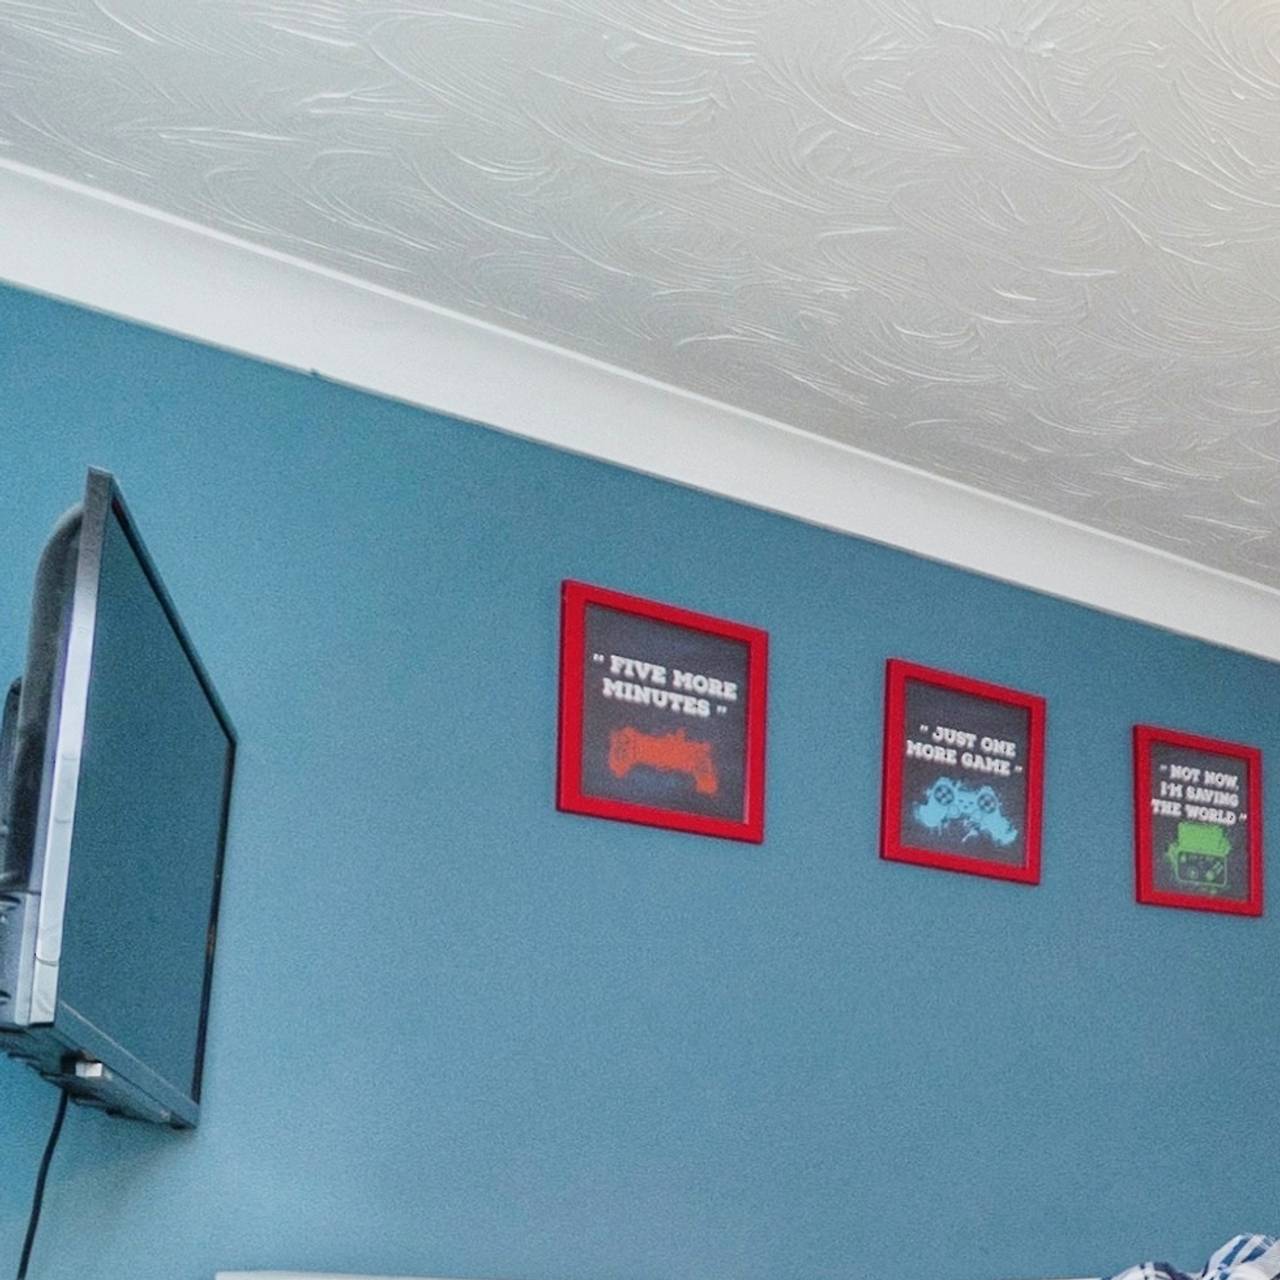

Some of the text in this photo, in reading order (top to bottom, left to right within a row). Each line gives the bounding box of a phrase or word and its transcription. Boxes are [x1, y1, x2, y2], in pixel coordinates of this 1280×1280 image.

[610, 655, 738, 700] FIVE MORE
[602, 677, 711, 717] MINUTES
[932, 725, 1016, 757] JUST ONE
[906, 739, 1011, 776] MORE GAME
[1170, 764, 1201, 783] NOT
[1151, 798, 1236, 825] THE WORLD
[1186, 785, 1239, 808] SAVING
